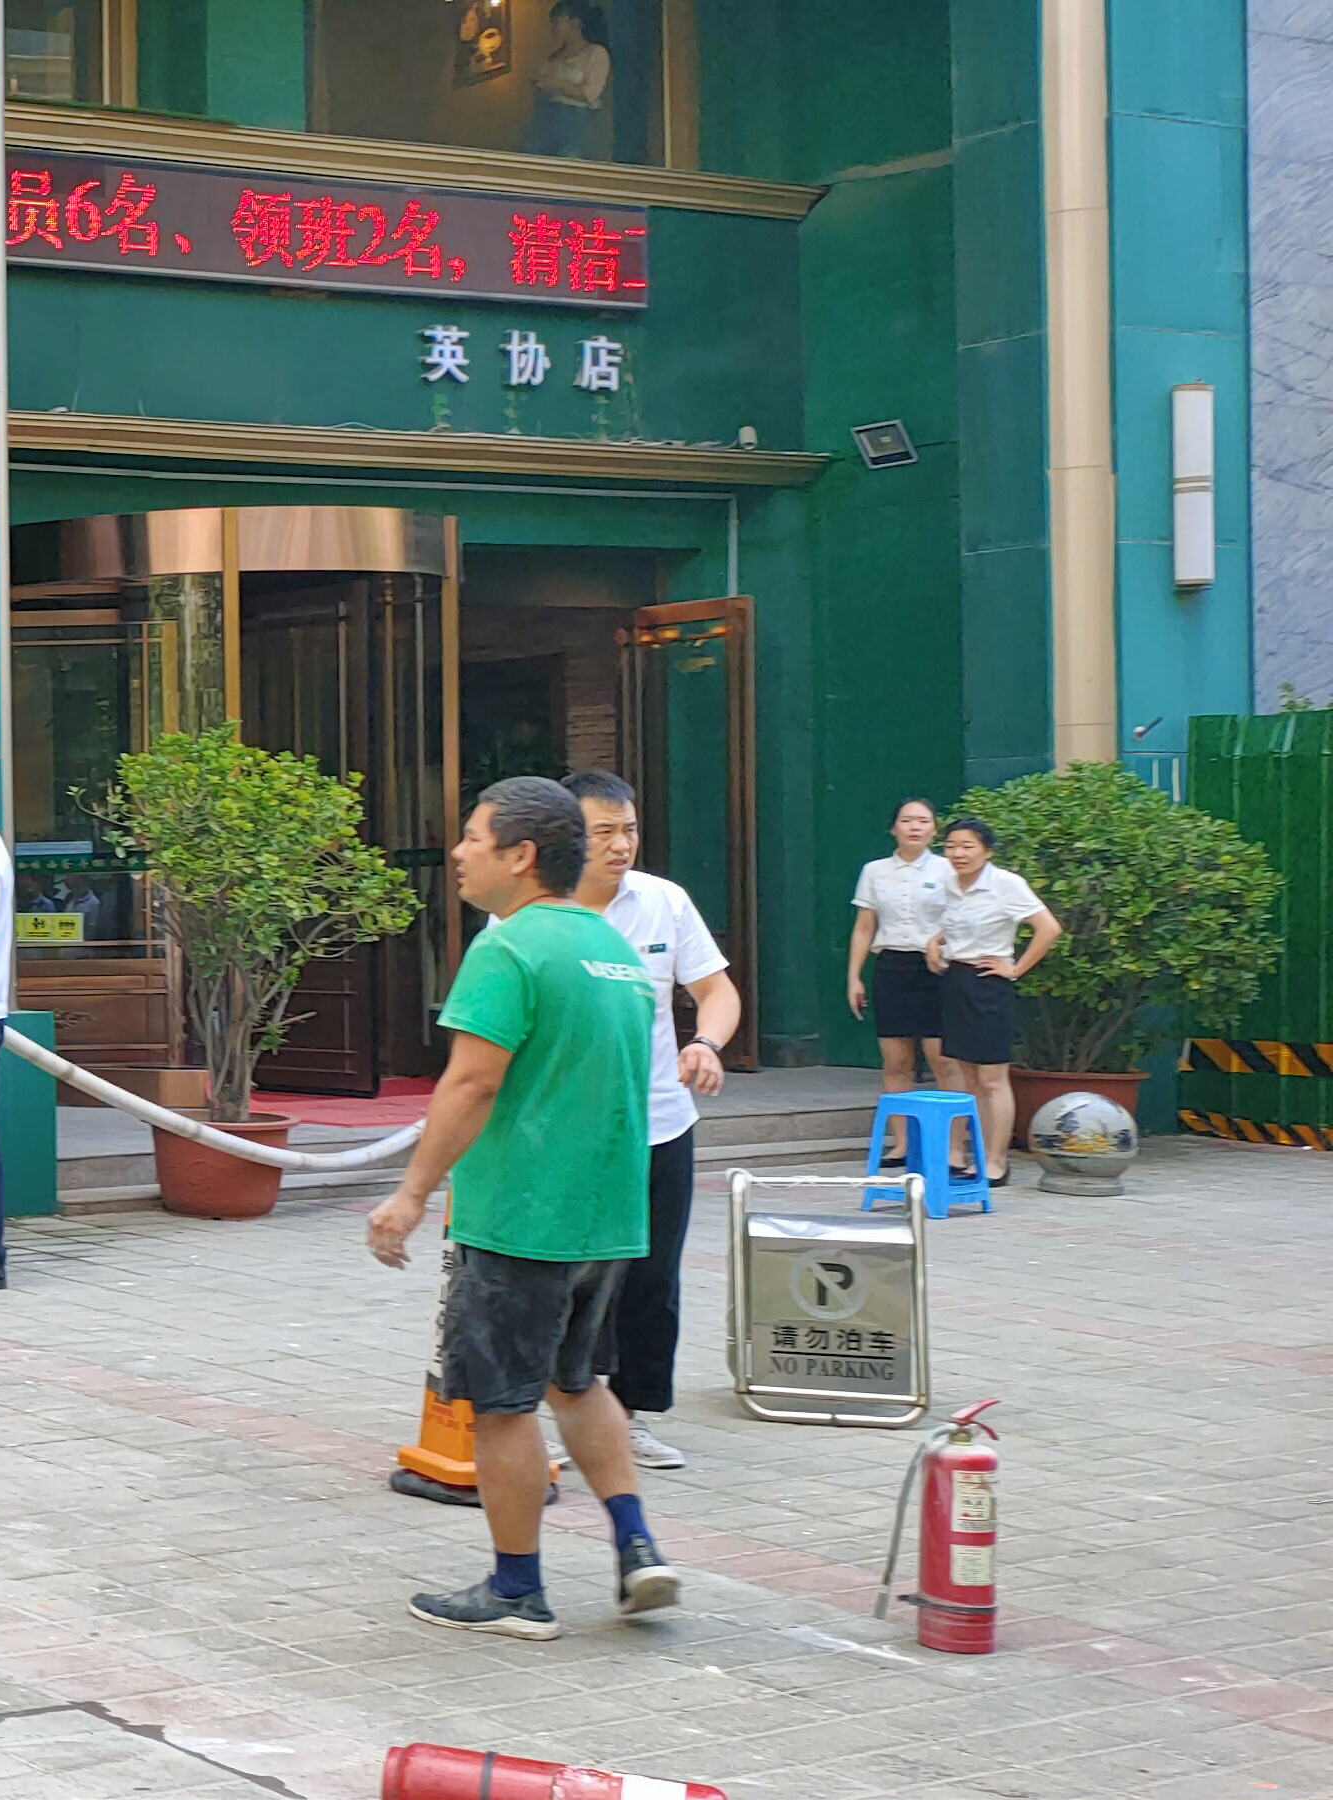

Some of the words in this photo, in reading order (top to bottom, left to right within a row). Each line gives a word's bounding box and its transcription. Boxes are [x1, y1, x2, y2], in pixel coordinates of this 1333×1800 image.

[417, 325, 624, 391] 英协店
[771, 1326, 895, 1353] 请勿泊车
[769, 1356, 798, 1375] NO
[806, 1358, 895, 1380] PARKING
